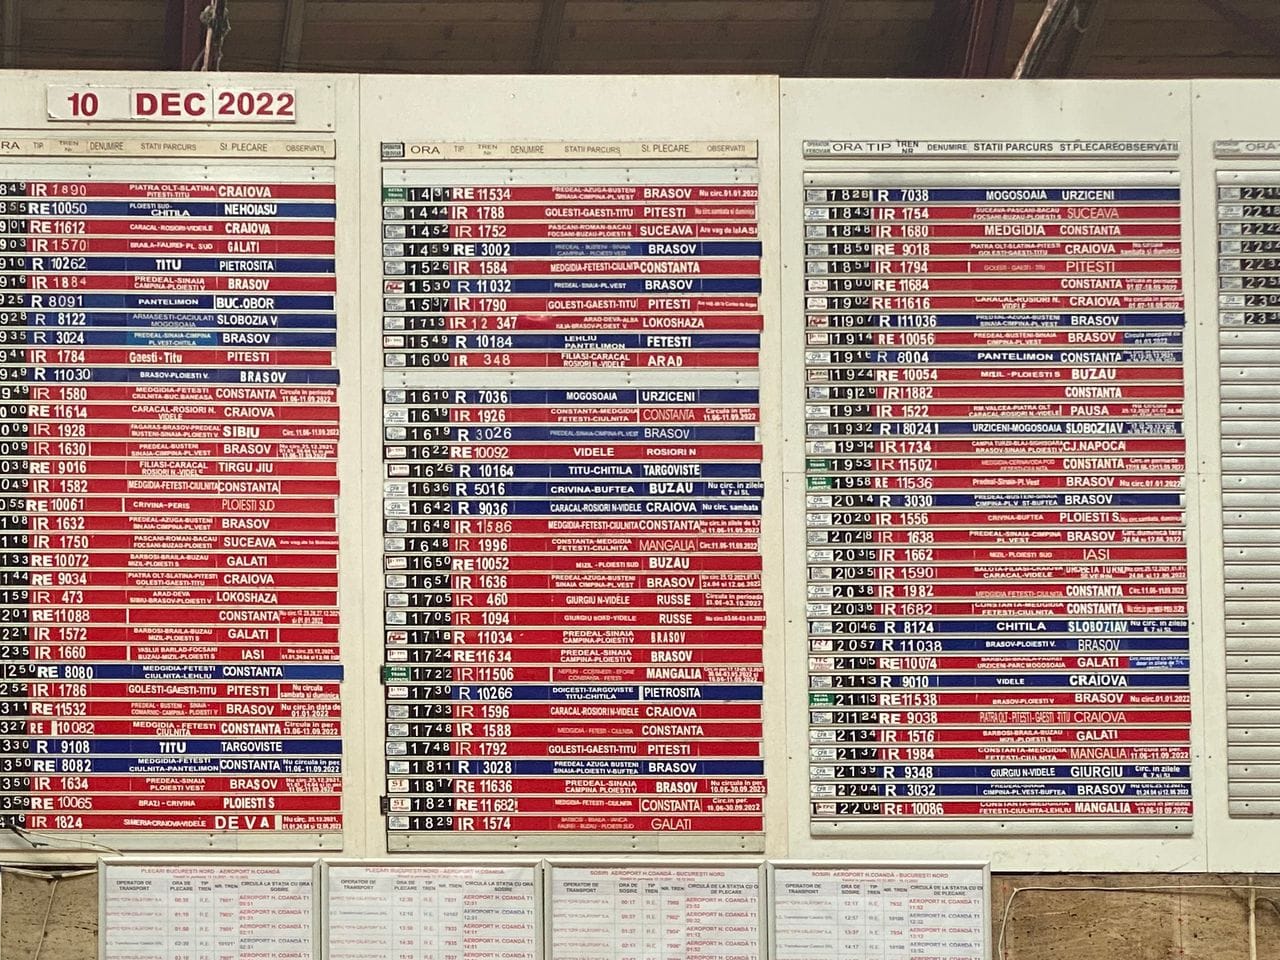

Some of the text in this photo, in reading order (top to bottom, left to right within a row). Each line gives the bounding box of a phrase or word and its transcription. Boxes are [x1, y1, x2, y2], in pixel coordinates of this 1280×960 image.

[67, 93, 99, 117] 10
[136, 93, 206, 117] DEC
[218, 93, 294, 117] 2022
[974, 142, 1053, 152] STATII PARCURS
[218, 185, 271, 198] CRAIOVA
[986, 190, 1115, 200] MOGOSOAIA URZICENI
[224, 204, 278, 215] NEHOIASU
[984, 225, 1121, 236] MEDGIDIA CONSTANTA
[155, 258, 274, 271] TITU PIETROSITA
[977, 353, 1053, 361] PANTELIMON
[566, 391, 695, 402] MOGOSOAIA URZICENI
[1070, 406, 1109, 416] PAUSA
[574, 447, 614, 457] VIDELE
[550, 483, 694, 494] CRIVINA-BUFTEA BUZAU
[223, 537, 276, 548] SUCEAVA
[227, 556, 268, 567] GALATI
[656, 594, 691, 606] RUSSE
[996, 622, 1046, 631] CHITILA
[646, 668, 702, 679] MANGALIA
[159, 741, 282, 753] TITU TARGOVISTE
[1070, 766, 1123, 777] GIURGIU
[1075, 802, 1131, 813] MANGALIA
